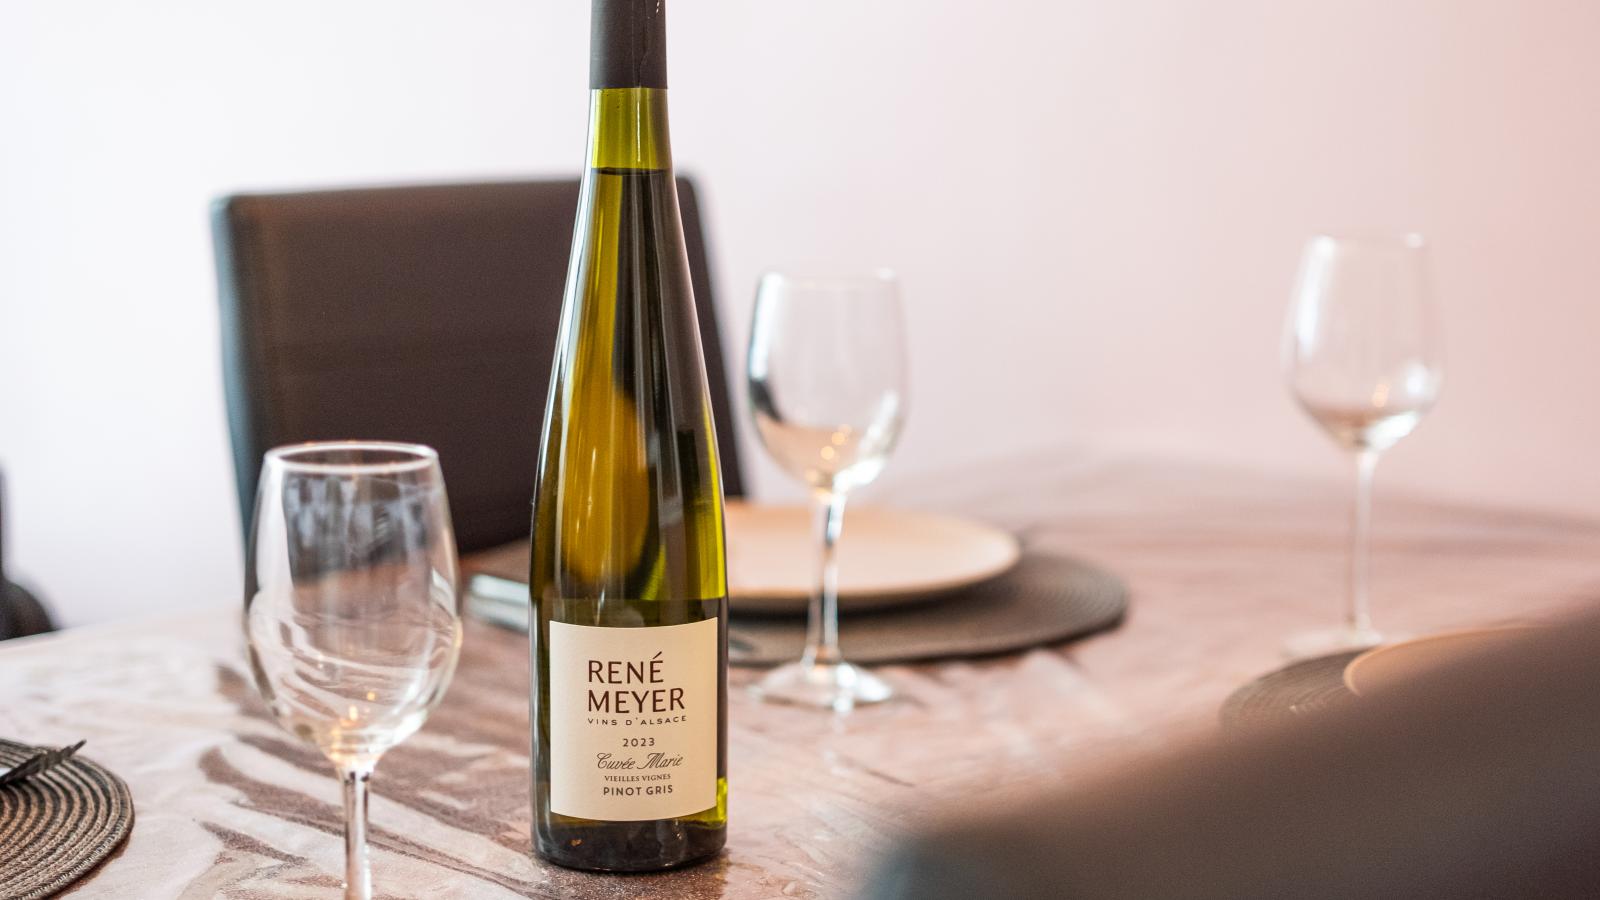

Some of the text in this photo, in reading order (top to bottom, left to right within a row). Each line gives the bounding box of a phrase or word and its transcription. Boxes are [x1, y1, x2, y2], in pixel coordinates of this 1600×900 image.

[588, 651, 664, 684] RENÉ
[588, 688, 685, 713] MEYER
[587, 715, 687, 726] VINS D'ALSACE
[622, 737, 655, 747] 2023
[596, 752, 684, 770] Cuvée Marie
[641, 773, 671, 781] VIGNES
[603, 784, 673, 796] PINOT GRIS
